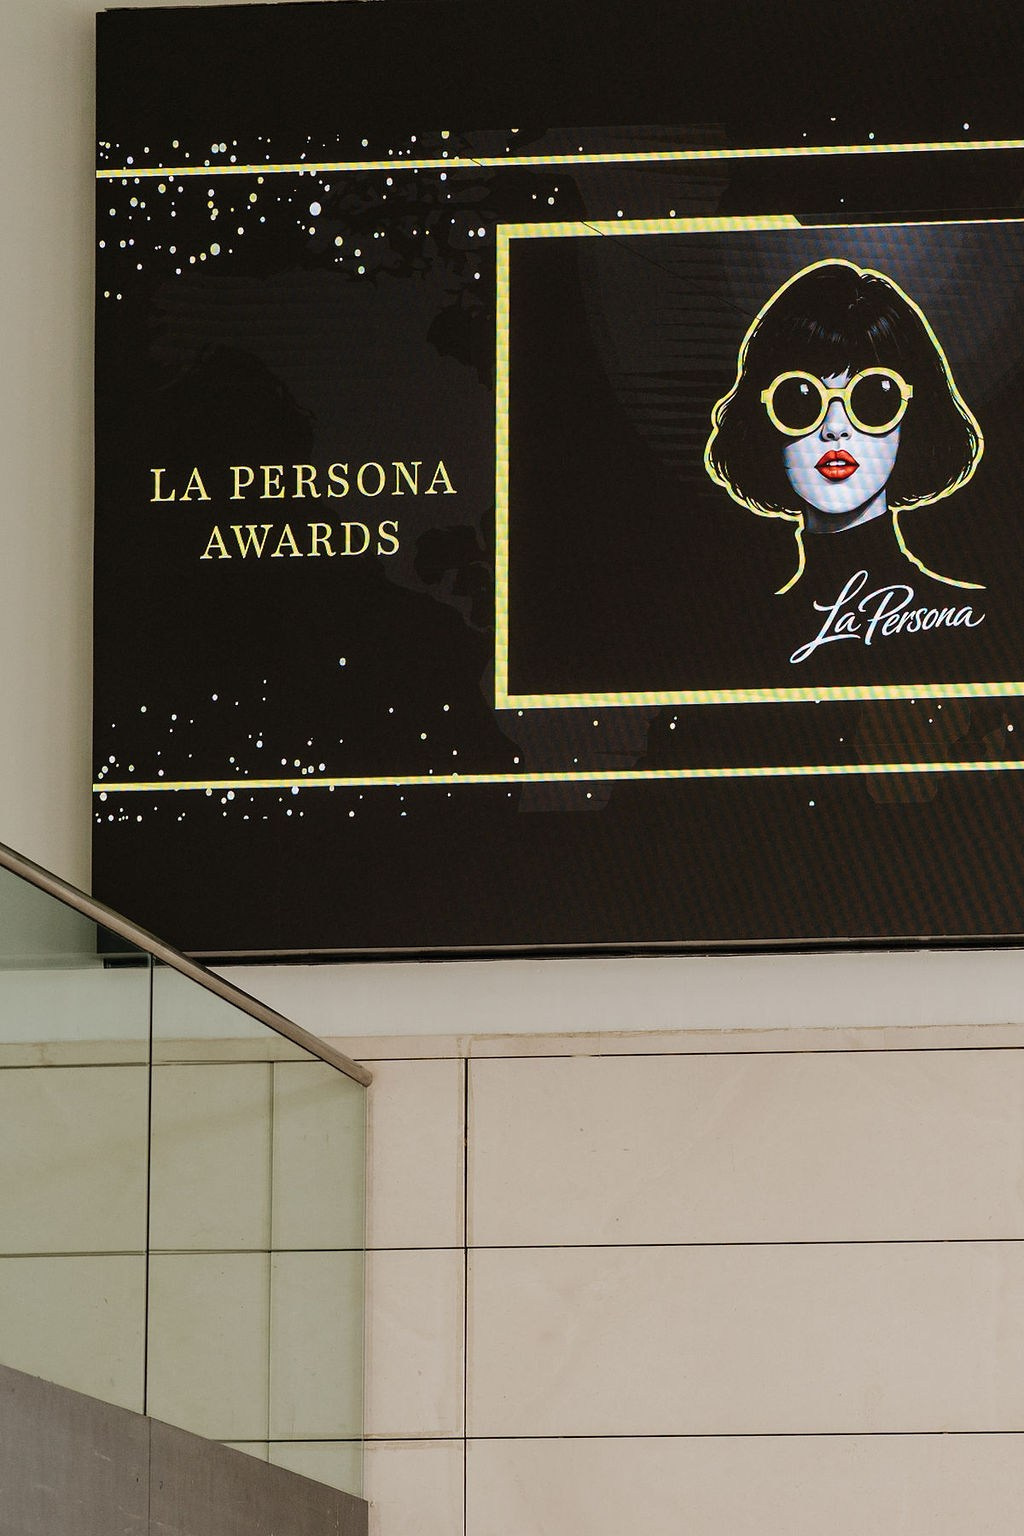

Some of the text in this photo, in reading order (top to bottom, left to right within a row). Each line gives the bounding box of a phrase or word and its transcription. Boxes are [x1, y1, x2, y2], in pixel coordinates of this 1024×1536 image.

[150, 460, 458, 502] LA PERSONA
[199, 520, 401, 560] AWARDS
[789, 569, 986, 664] La Persona
